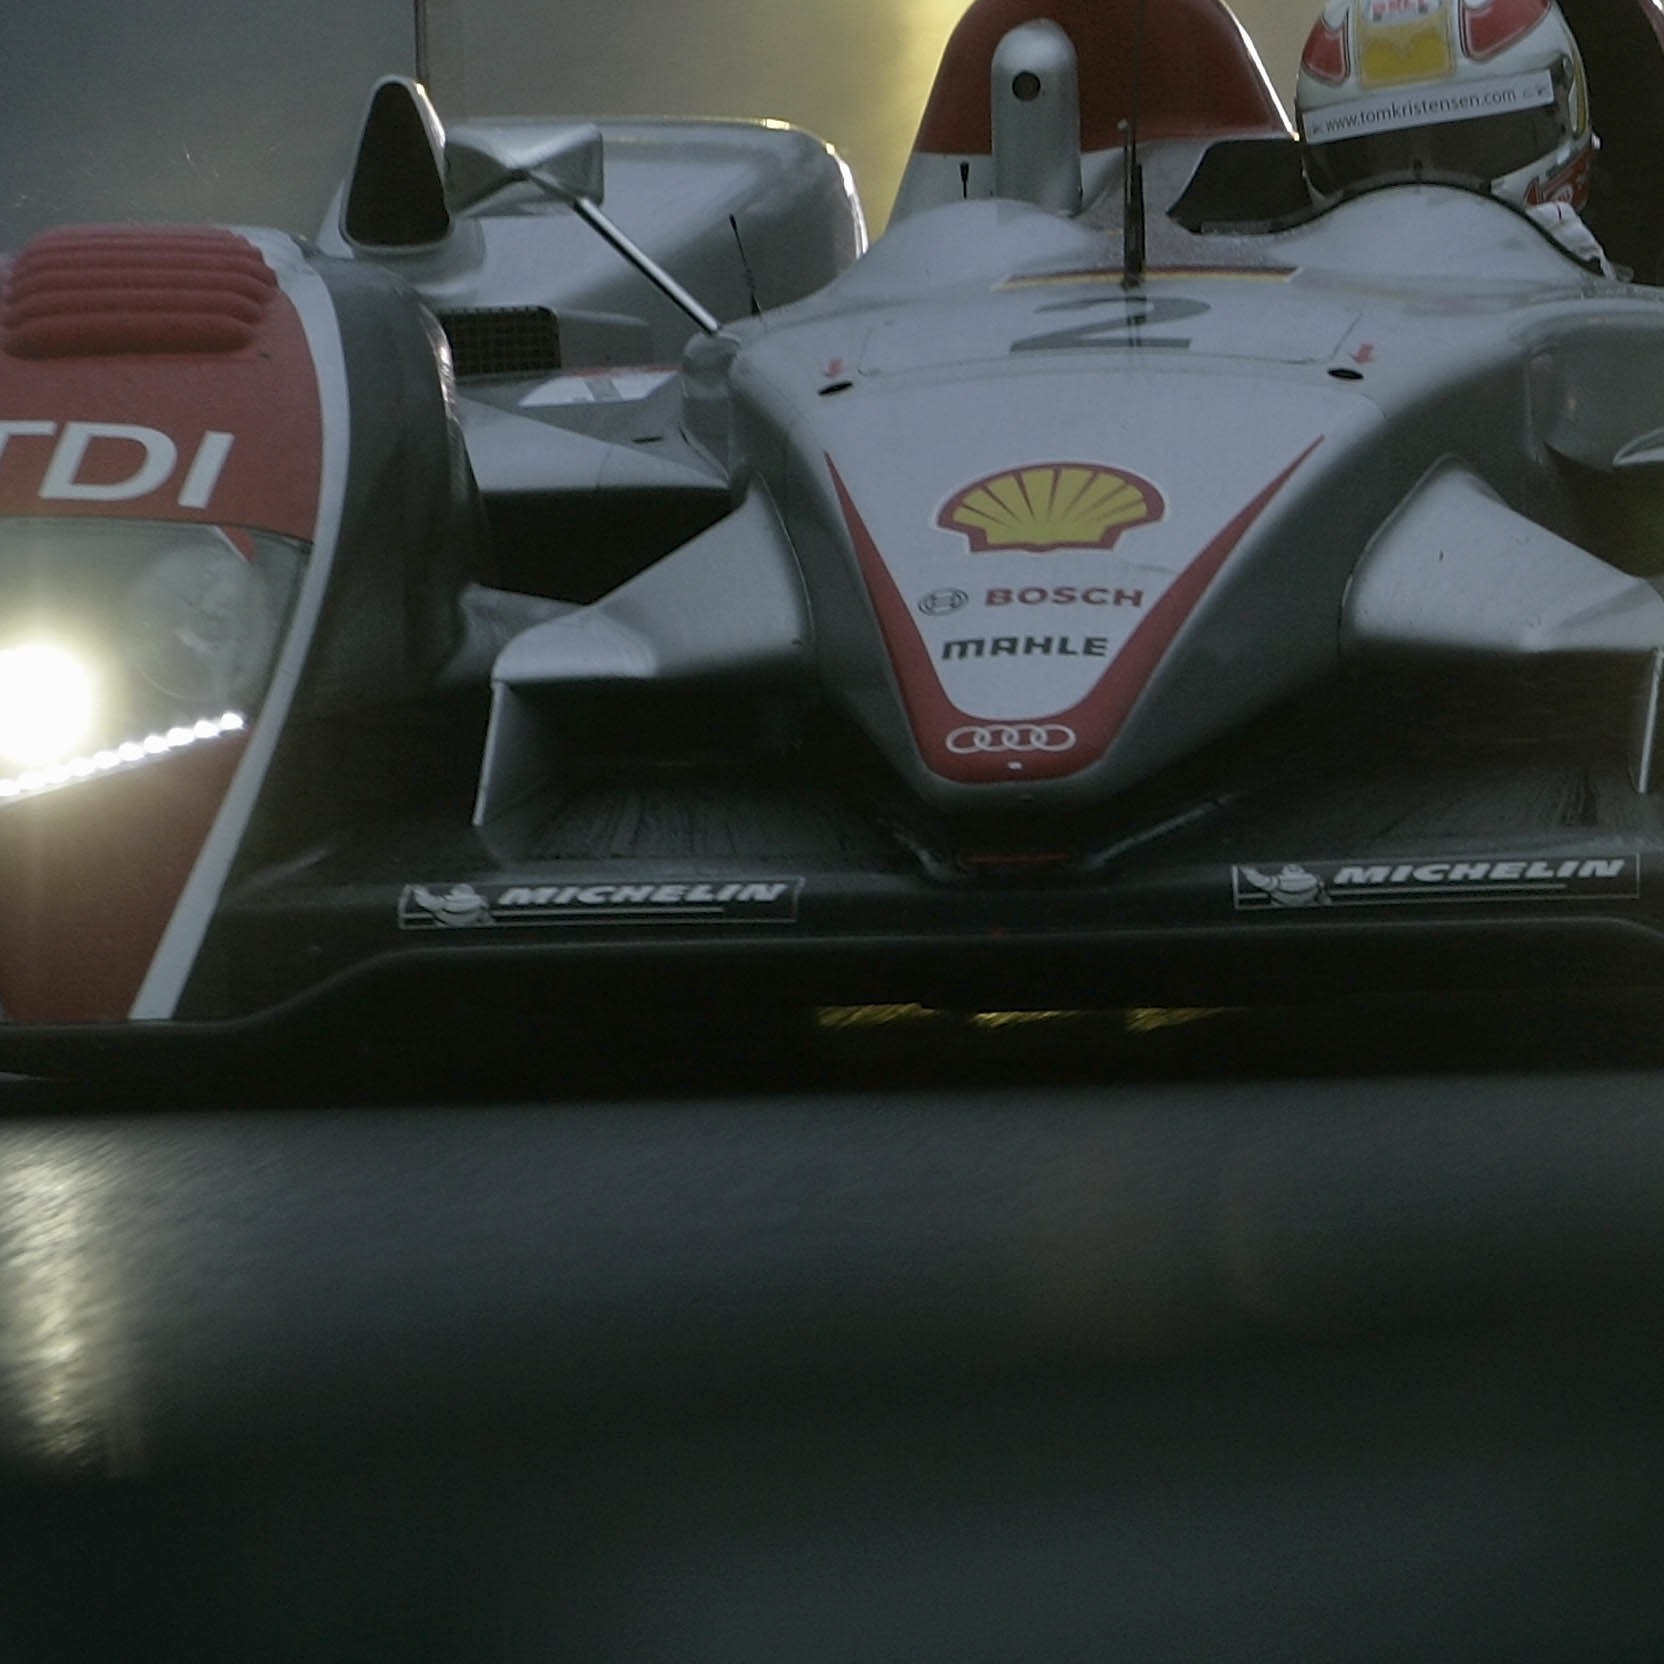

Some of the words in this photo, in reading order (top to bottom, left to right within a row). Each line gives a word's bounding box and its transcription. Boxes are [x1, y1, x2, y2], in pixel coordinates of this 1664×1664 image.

[1324, 88, 1517, 132] www.tomkristensen.com
[1009, 296, 1212, 353] 2
[984, 587, 1144, 608] BOSCH
[941, 636, 1109, 661] MAHLE
[1335, 859, 1625, 886] MICHELIN
[497, 882, 787, 906] MICHELIN
